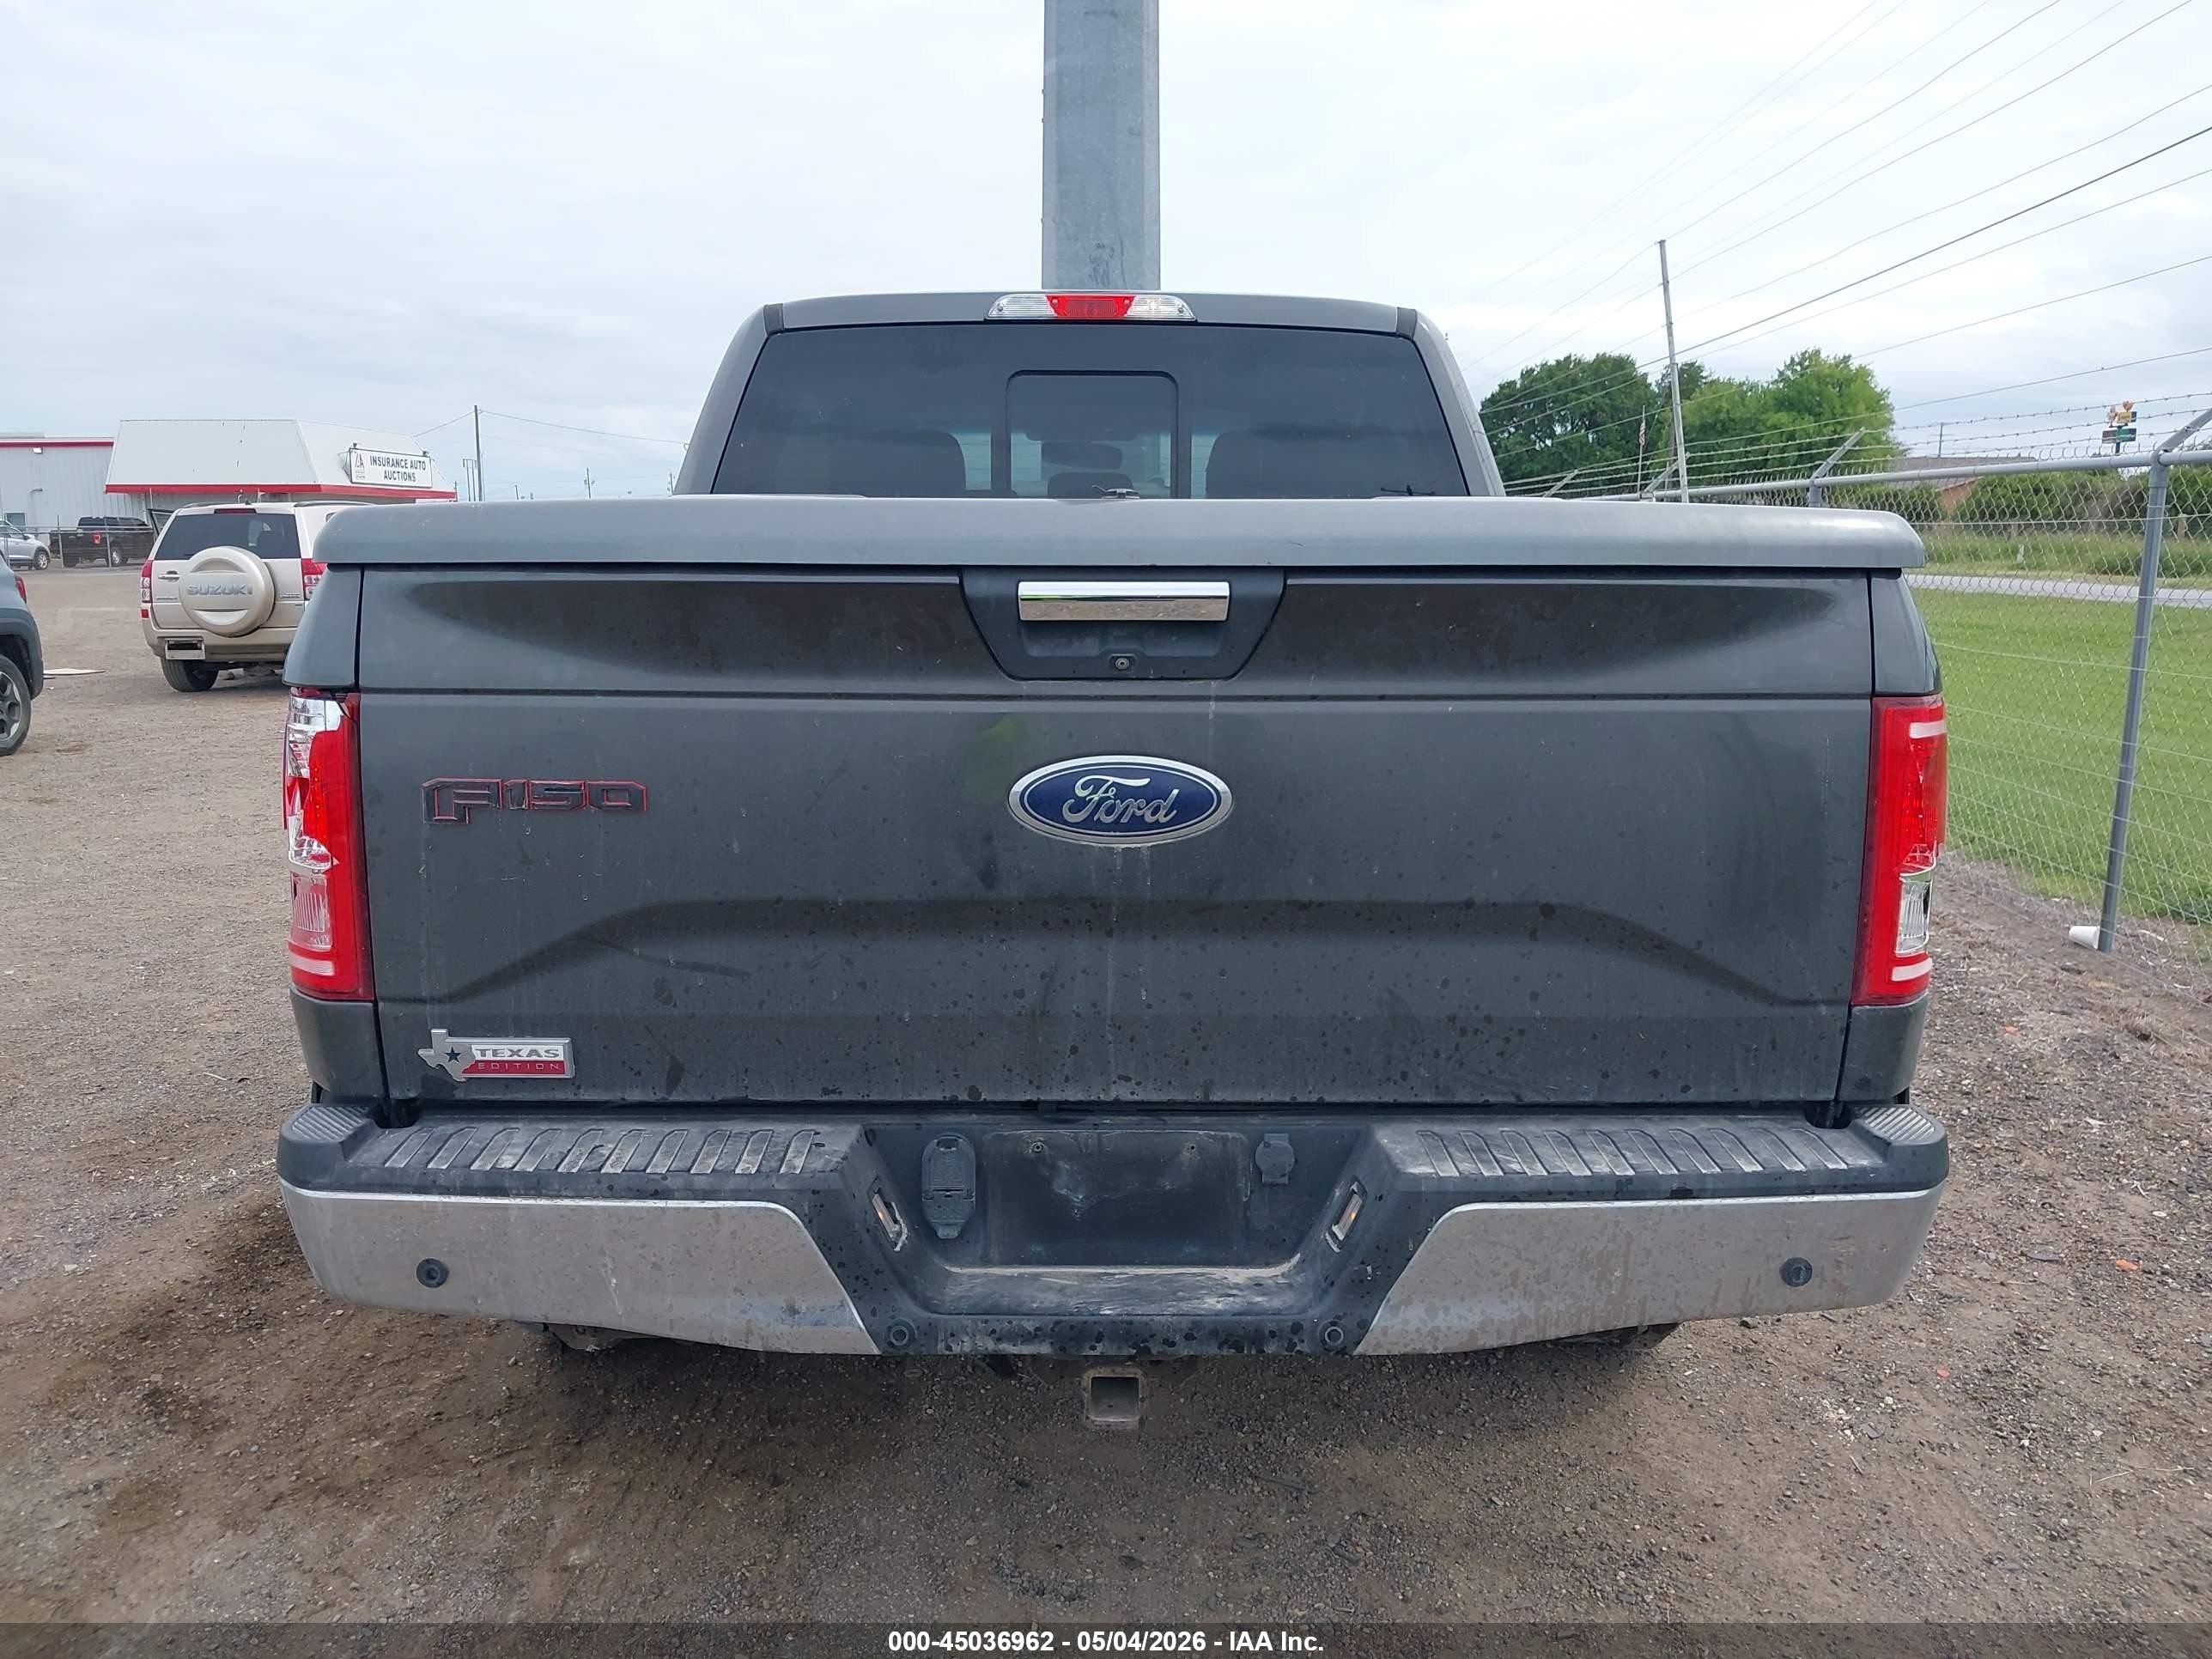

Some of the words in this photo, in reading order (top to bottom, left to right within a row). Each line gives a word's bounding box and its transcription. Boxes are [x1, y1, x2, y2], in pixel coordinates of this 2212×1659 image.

[370, 455, 408, 469] INSURANCE
[410, 460, 426, 471] AUTO
[384, 471, 416, 482] AUCTIONS
[187, 584, 252, 595] SUZUKI
[1062, 775, 1179, 823] Ford
[474, 1048, 560, 1058] TEXAS
